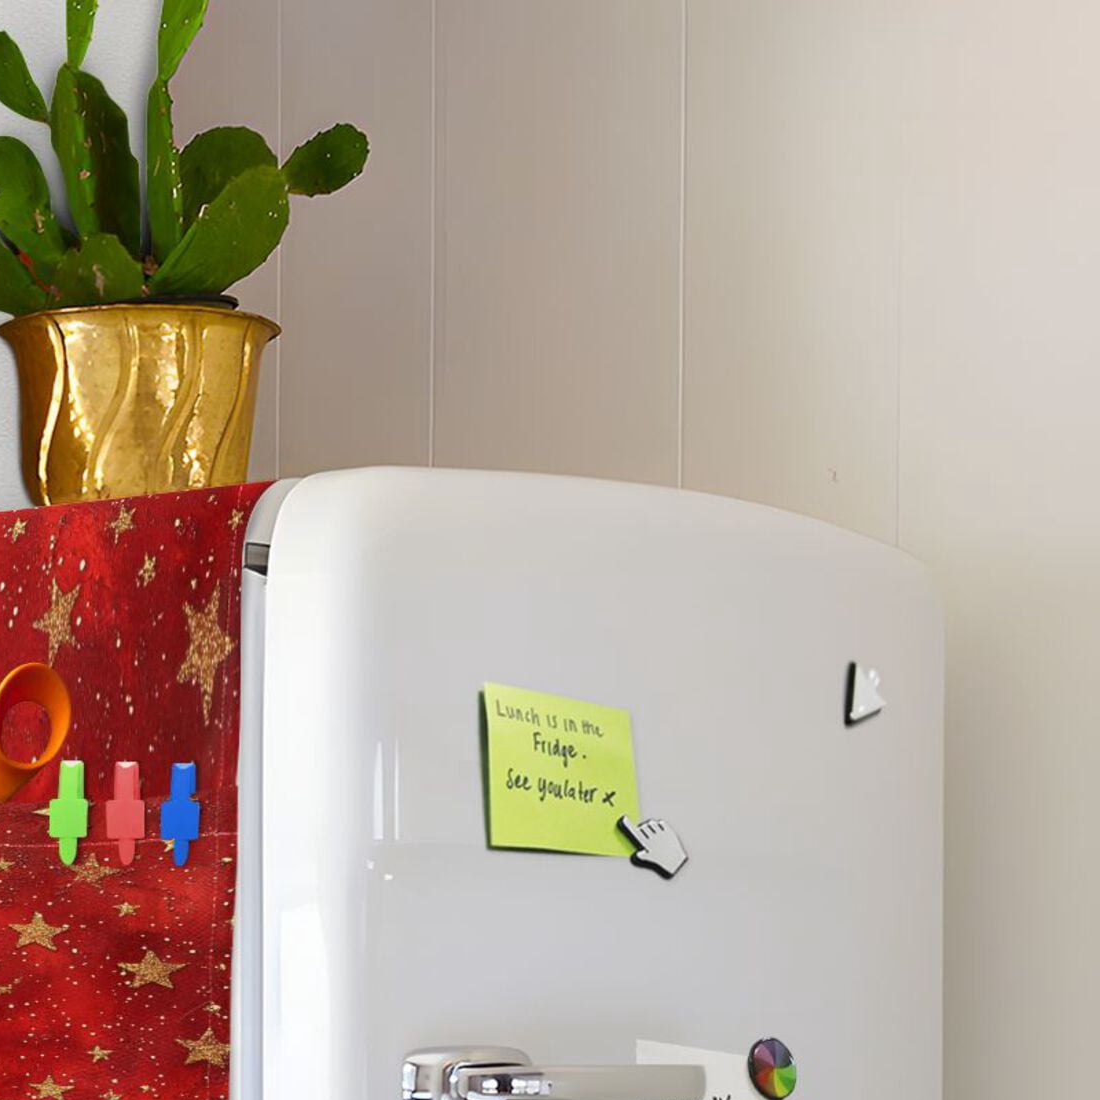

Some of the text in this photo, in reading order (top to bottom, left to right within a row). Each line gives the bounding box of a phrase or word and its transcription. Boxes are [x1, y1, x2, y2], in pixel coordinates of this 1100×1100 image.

[495, 699, 604, 738] Lunch is in the
[506, 768, 532, 791] See
